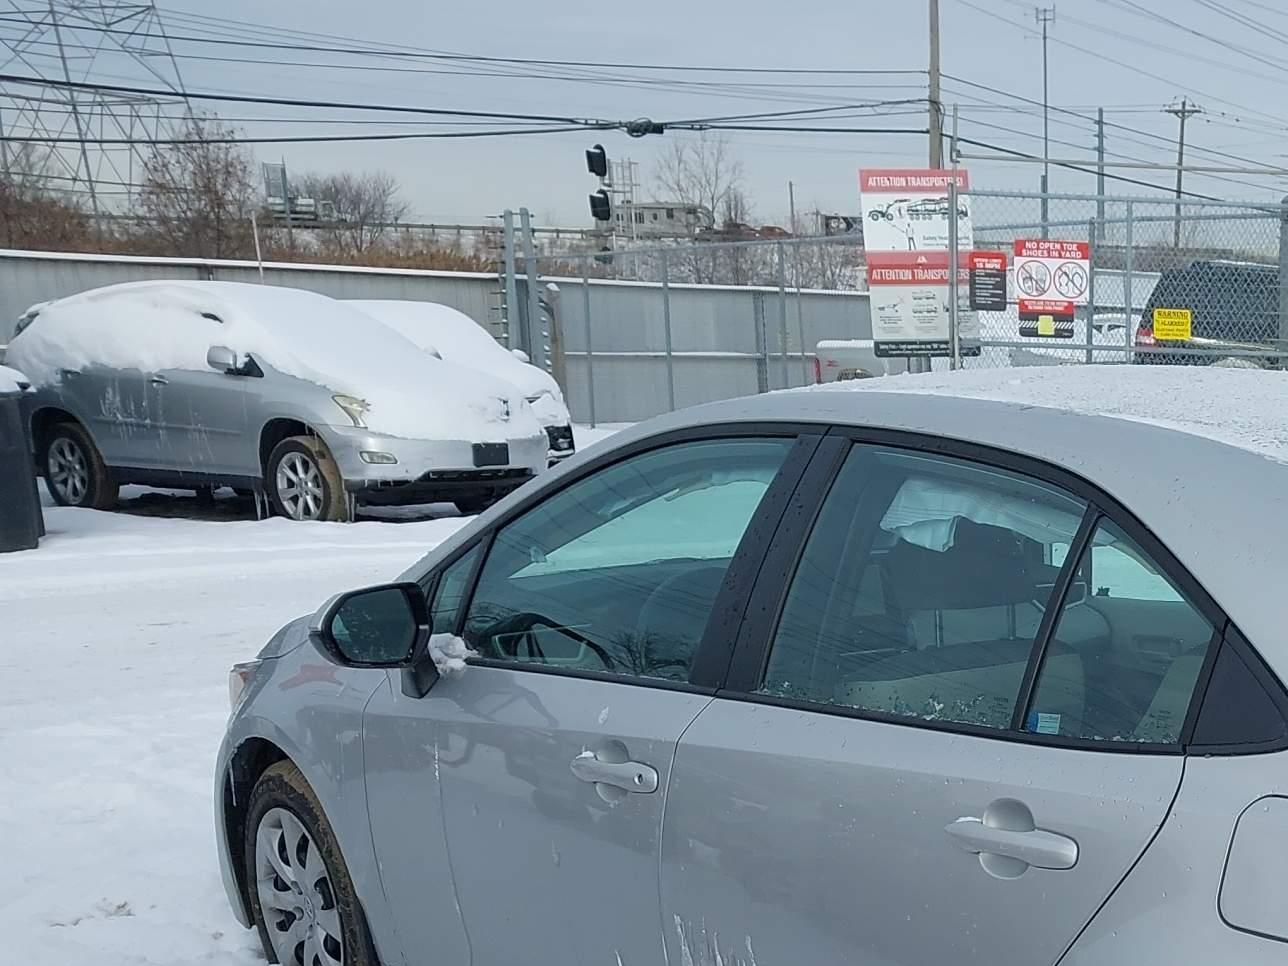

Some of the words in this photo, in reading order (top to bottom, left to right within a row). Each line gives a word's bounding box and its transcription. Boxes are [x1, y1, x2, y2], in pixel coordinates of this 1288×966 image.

[867, 176, 906, 187] ATTENTION
[1025, 241, 1038, 249] NO
[1039, 241, 1061, 250] OPEN
[1062, 243, 1078, 251] TOE
[1021, 249, 1049, 257] SHOES
[1061, 250, 1082, 259] YARD
[872, 268, 912, 280] ATTENTION
